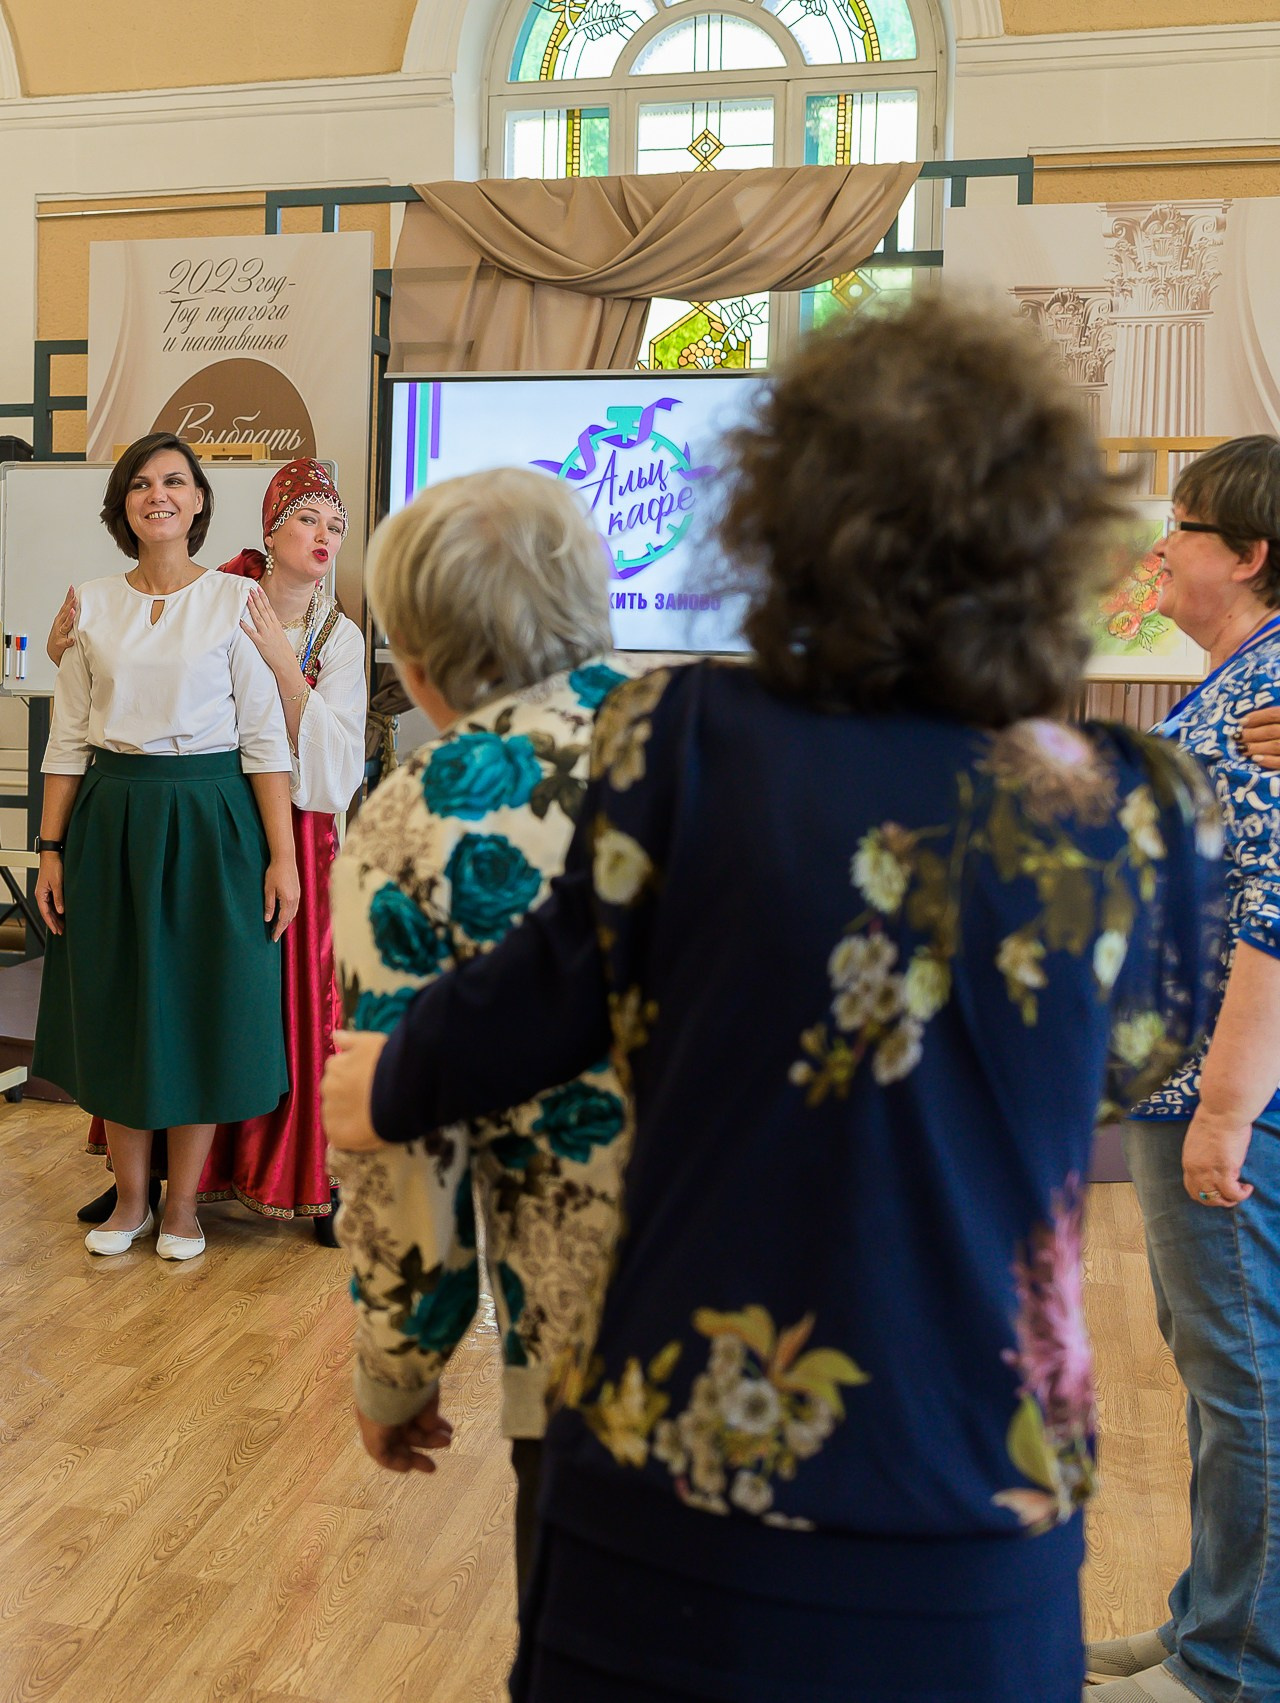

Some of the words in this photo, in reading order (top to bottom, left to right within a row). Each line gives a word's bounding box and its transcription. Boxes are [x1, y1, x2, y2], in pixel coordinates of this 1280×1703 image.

[162, 336, 178, 352] и
[180, 323, 289, 352] наставника
[163, 297, 204, 334] Год
[205, 304, 290, 333] педагога
[175, 402, 306, 450] Выбрать
[577, 450, 669, 514] Альц
[608, 487, 696, 535] кафе
